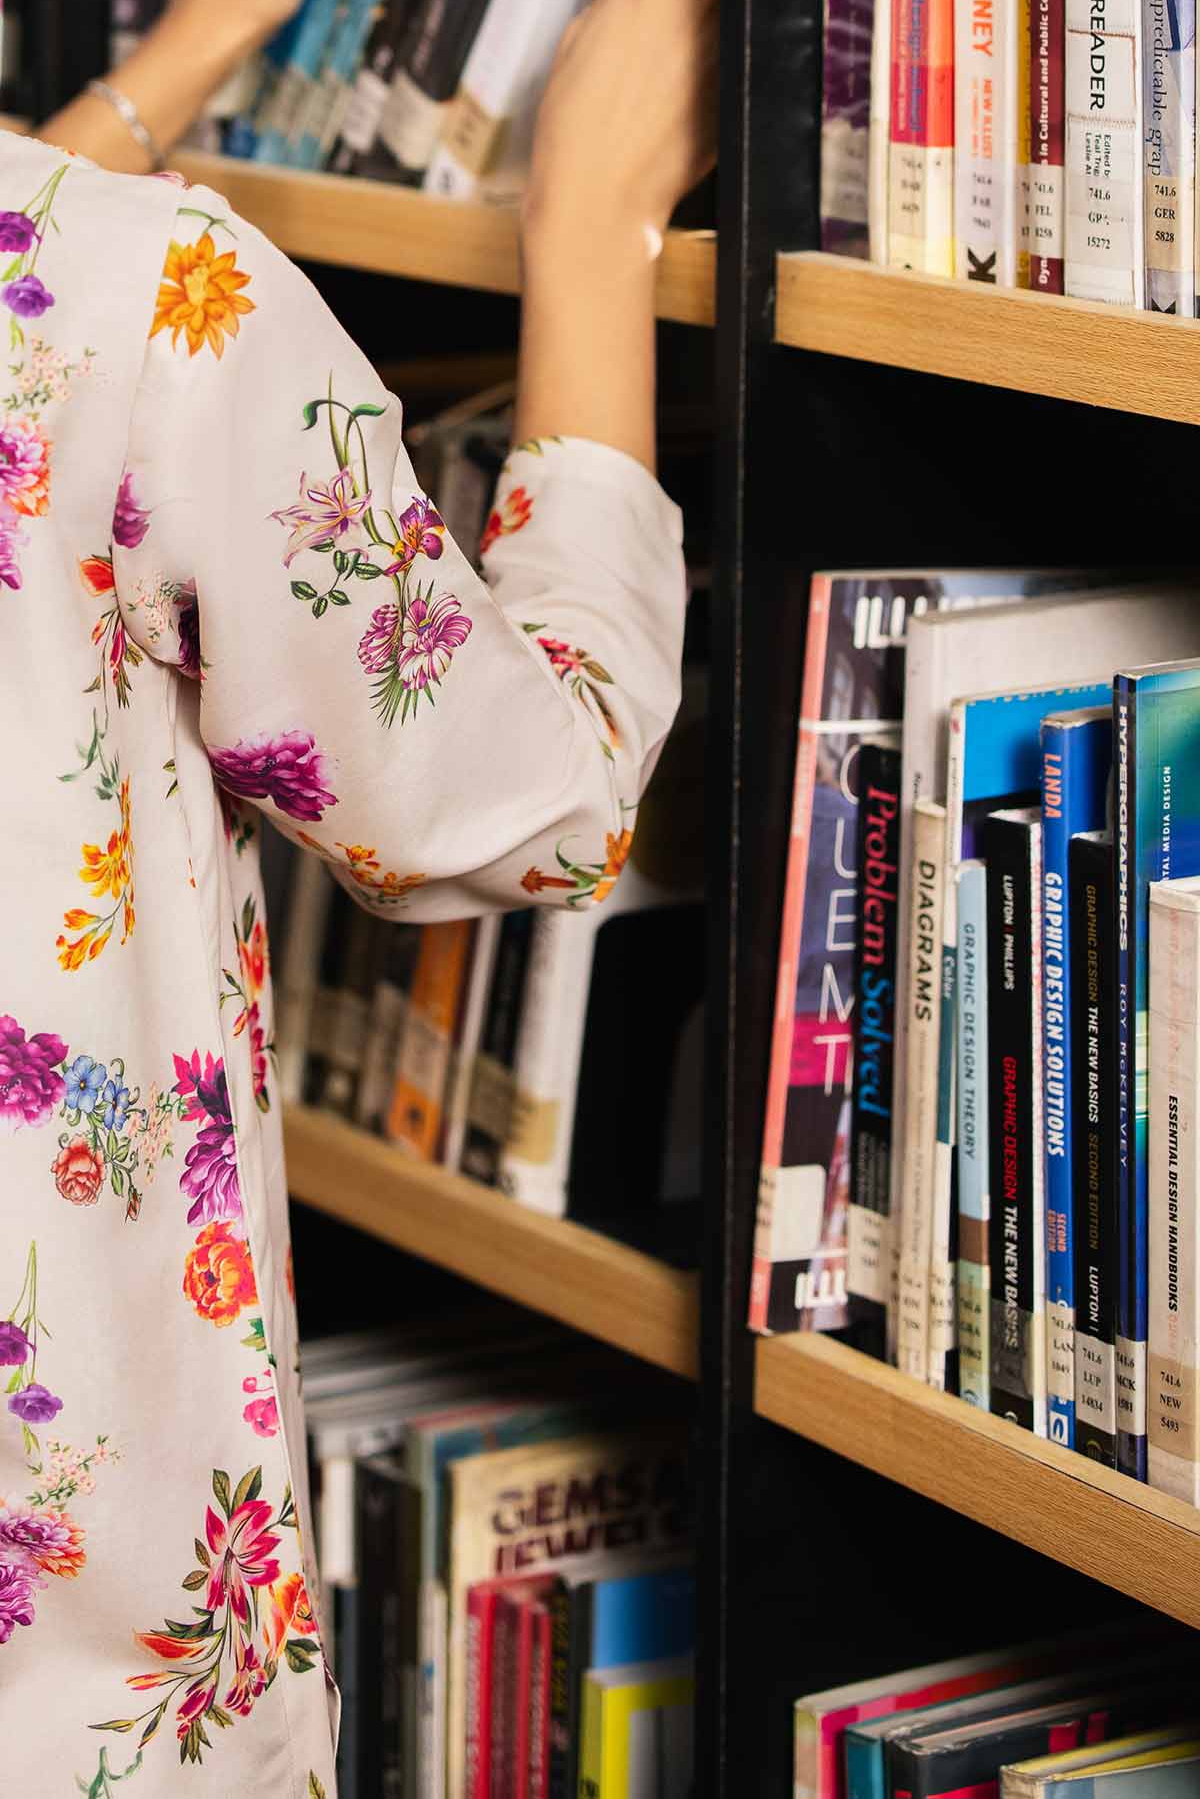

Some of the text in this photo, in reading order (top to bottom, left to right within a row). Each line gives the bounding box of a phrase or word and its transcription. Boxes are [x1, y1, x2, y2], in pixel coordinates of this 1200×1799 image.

[1040, 14, 1049, 52] Public
[1040, 58, 1049, 83] and
[1040, 85, 1049, 140] Cultural
[1040, 143, 1049, 154] in
[1085, 132, 1093, 160] Leslie
[1104, 134, 1112, 163] Edited
[1145, 129, 1162, 178] grap
[1088, 186, 1111, 200] 741.6
[1154, 184, 1177, 198] 741.6
[1154, 206, 1176, 221] GER
[1087, 235, 1111, 250] 15272
[1155, 230, 1175, 243] 5828
[966, 246, 997, 284] K
[1043, 752, 1063, 819] LANDA
[1162, 765, 1172, 852] MEDIA DESIGN
[863, 784, 899, 966] Problem
[914, 859, 937, 1022] DIAGRAMS
[1002, 874, 1014, 991] LUPTON PHILLIPS
[1118, 704, 1128, 1169] HYPERGRAPHICS ROY McKELVEY
[1045, 872, 1065, 1157] GRAPHIC DESIGN SOLUTIONS
[858, 969, 893, 1121] Solved
[962, 922, 976, 1160] GRAPHIC DESIGN THEORY
[1086, 884, 1100, 1322] GRAPHIC DESIGN THE NEW BASICS SECOND EDITION LUPTON
[1168, 1094, 1179, 1169] ESSENTIAL
[1002, 1056, 1019, 1349] GRAPHIC DESIGN THE NEW BASICS
[1168, 1170, 1179, 1223] DESIGN
[1048, 1209, 1057, 1253] EDITION
[1057, 1213, 1067, 1253] SECOND
[1167, 1225, 1178, 1313] HANDBOOKS
[1053, 1338, 1075, 1353] LAN
[1082, 1347, 1103, 1365] 741.6
[1082, 1370, 1102, 1387] LUP
[1160, 1371, 1182, 1388] 741.6
[1159, 1393, 1183, 1411] NEW
[1160, 1417, 1180, 1432] 5493
